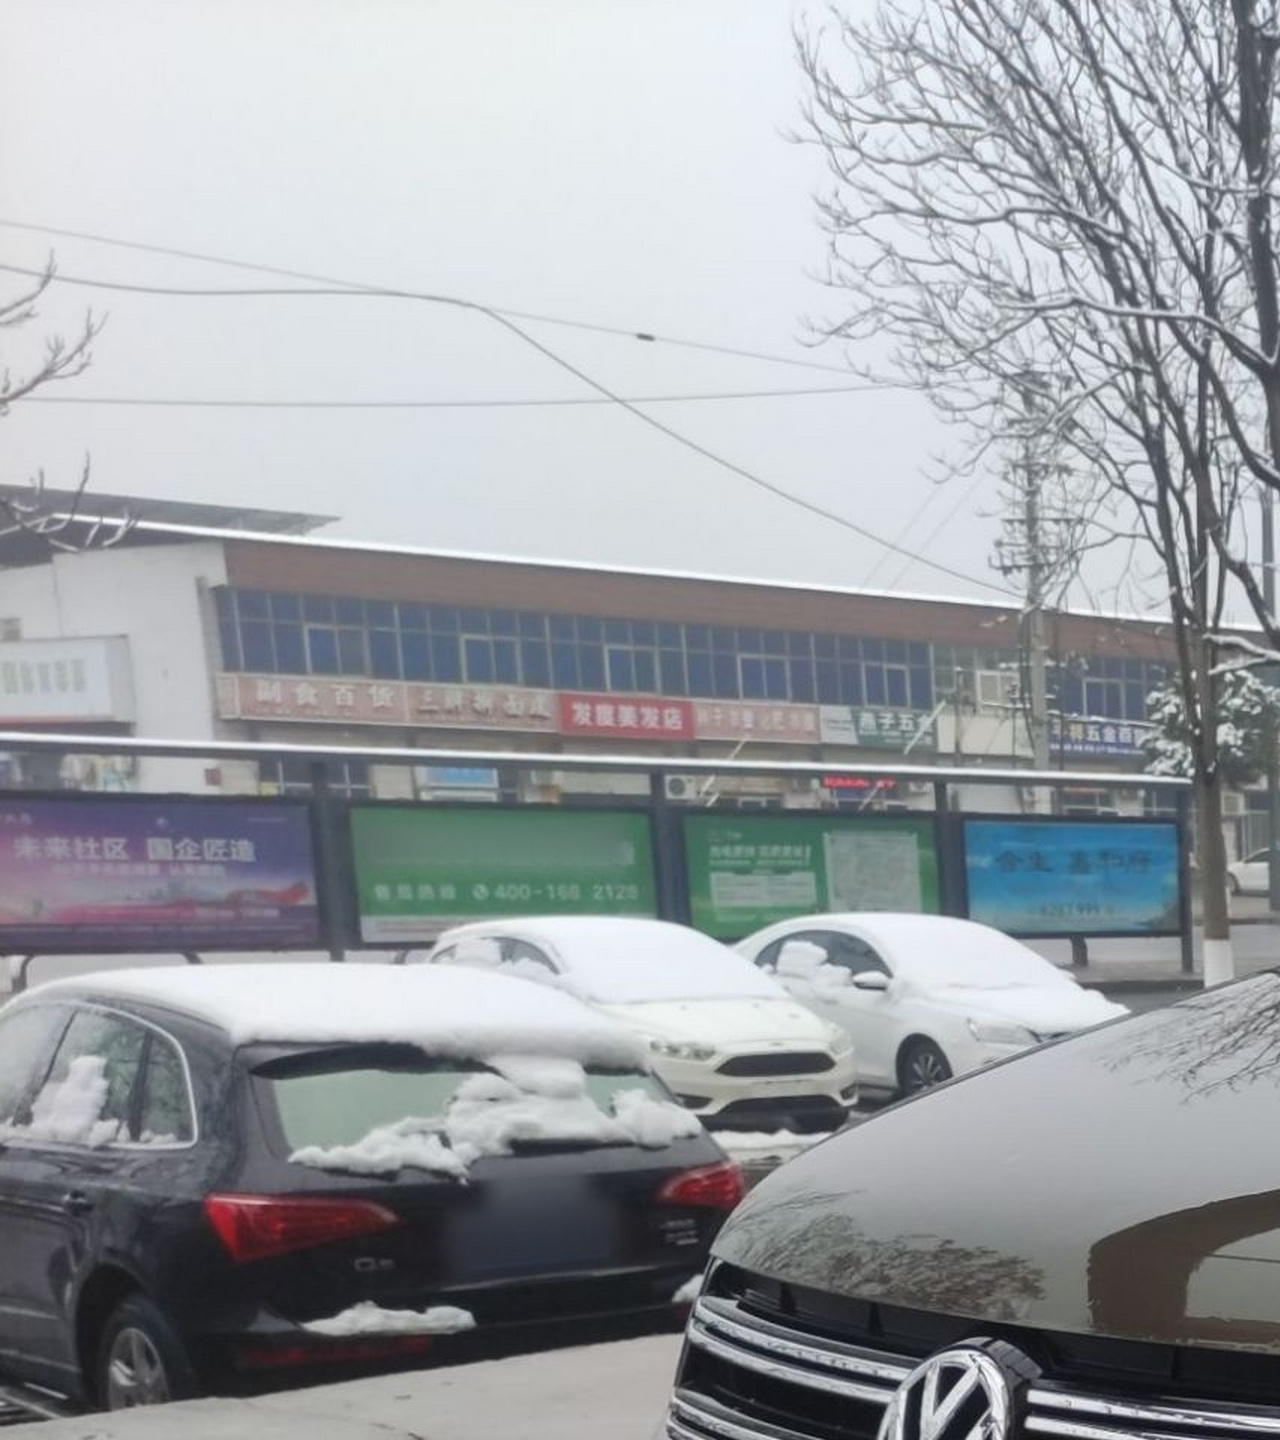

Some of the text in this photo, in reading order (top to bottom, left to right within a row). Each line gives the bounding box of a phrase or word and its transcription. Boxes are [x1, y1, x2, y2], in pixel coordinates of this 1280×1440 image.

[12, 836, 256, 863] 未来社区 国企匠造
